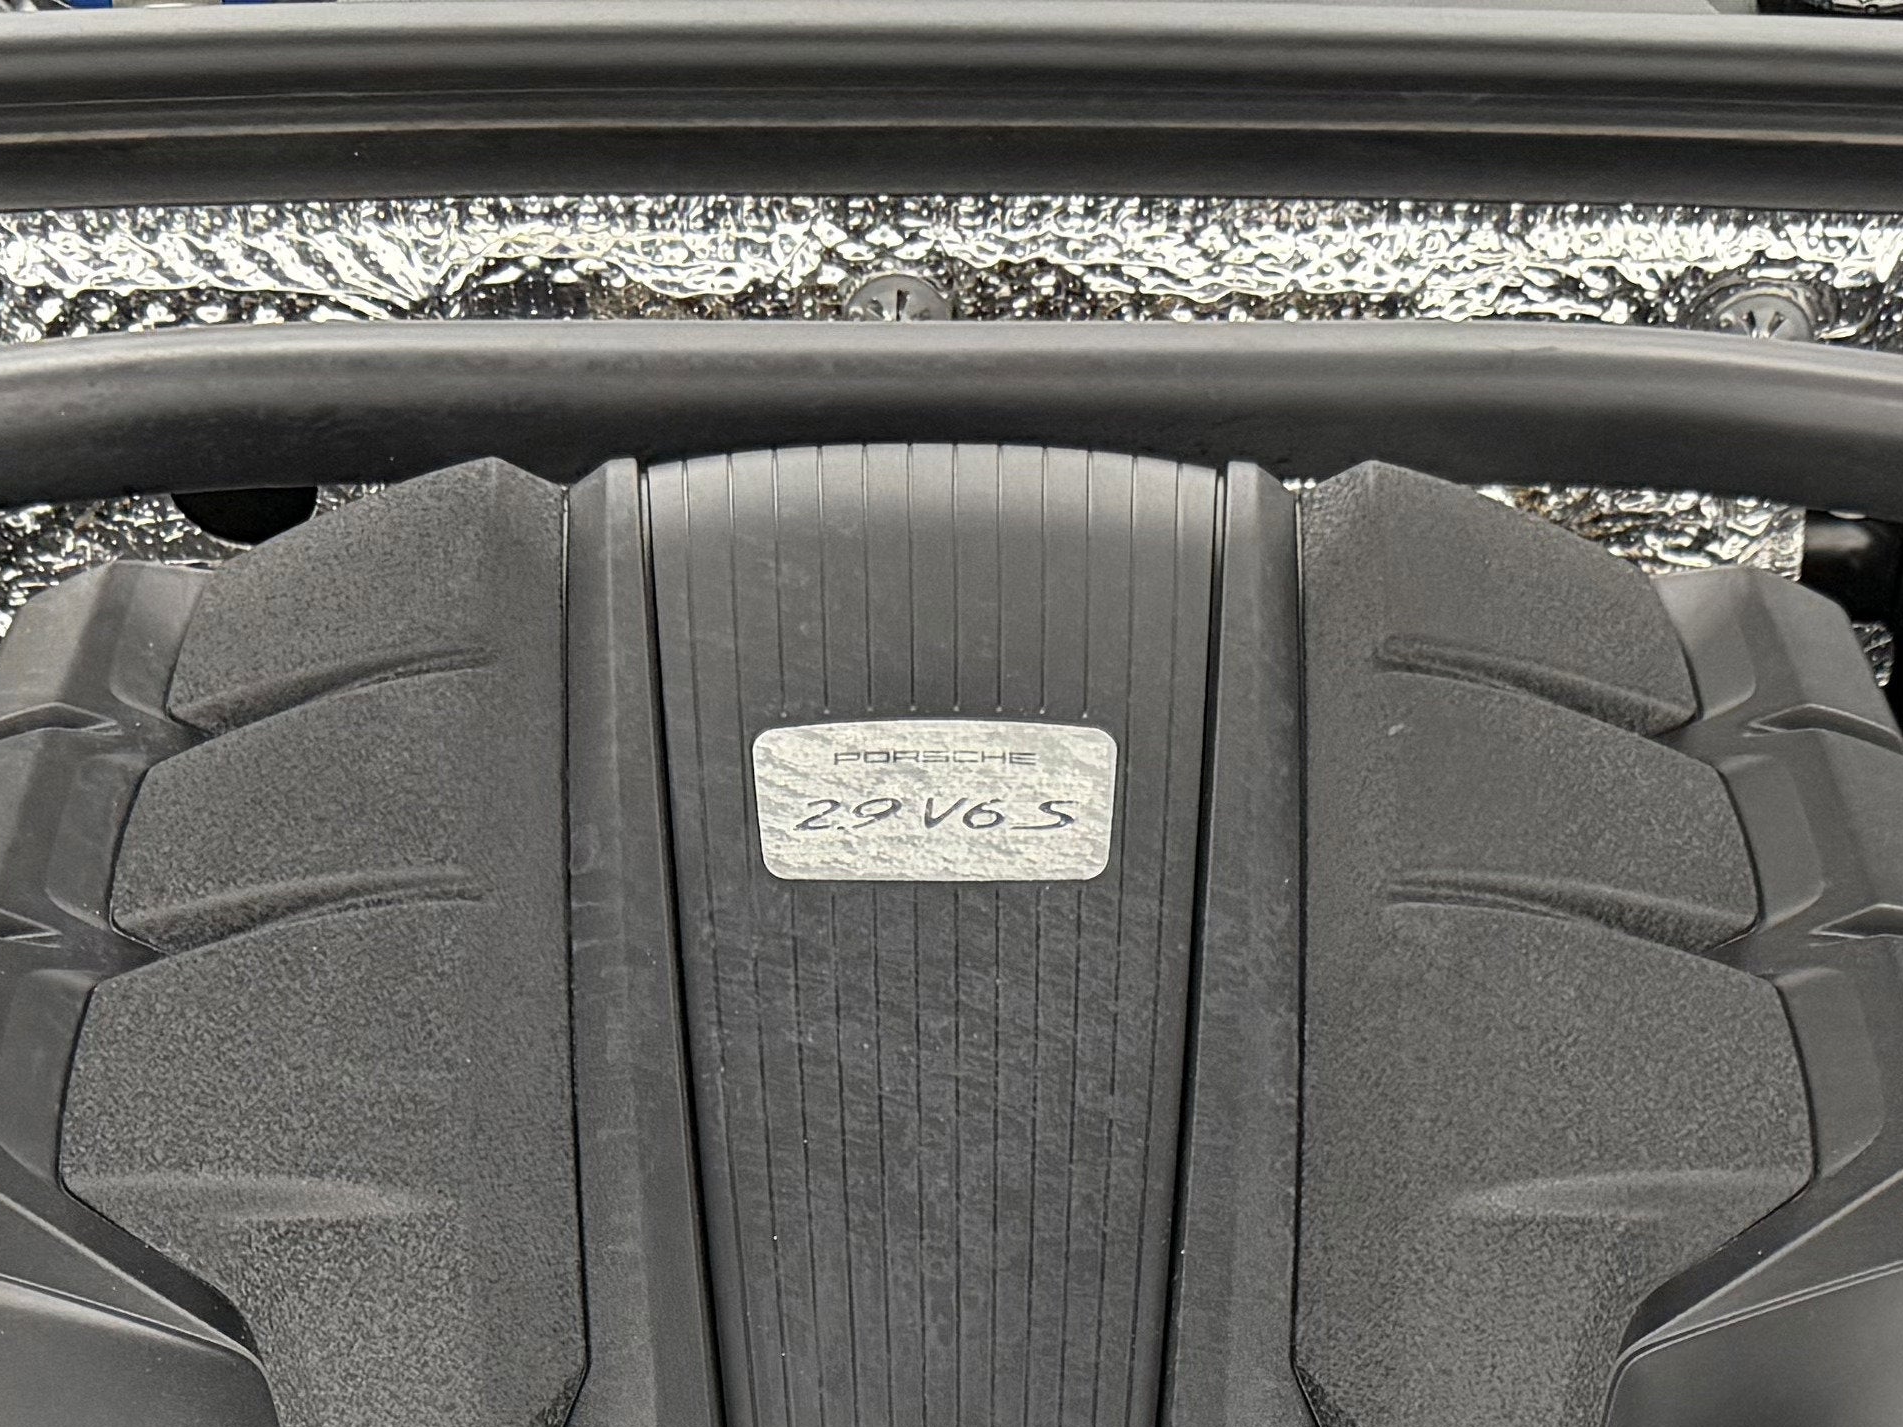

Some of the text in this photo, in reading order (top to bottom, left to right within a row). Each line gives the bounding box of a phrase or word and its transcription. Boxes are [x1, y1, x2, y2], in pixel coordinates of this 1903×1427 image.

[833, 750, 1038, 766] PORSCHE
[792, 796, 1079, 832] 2.9 V6 S
